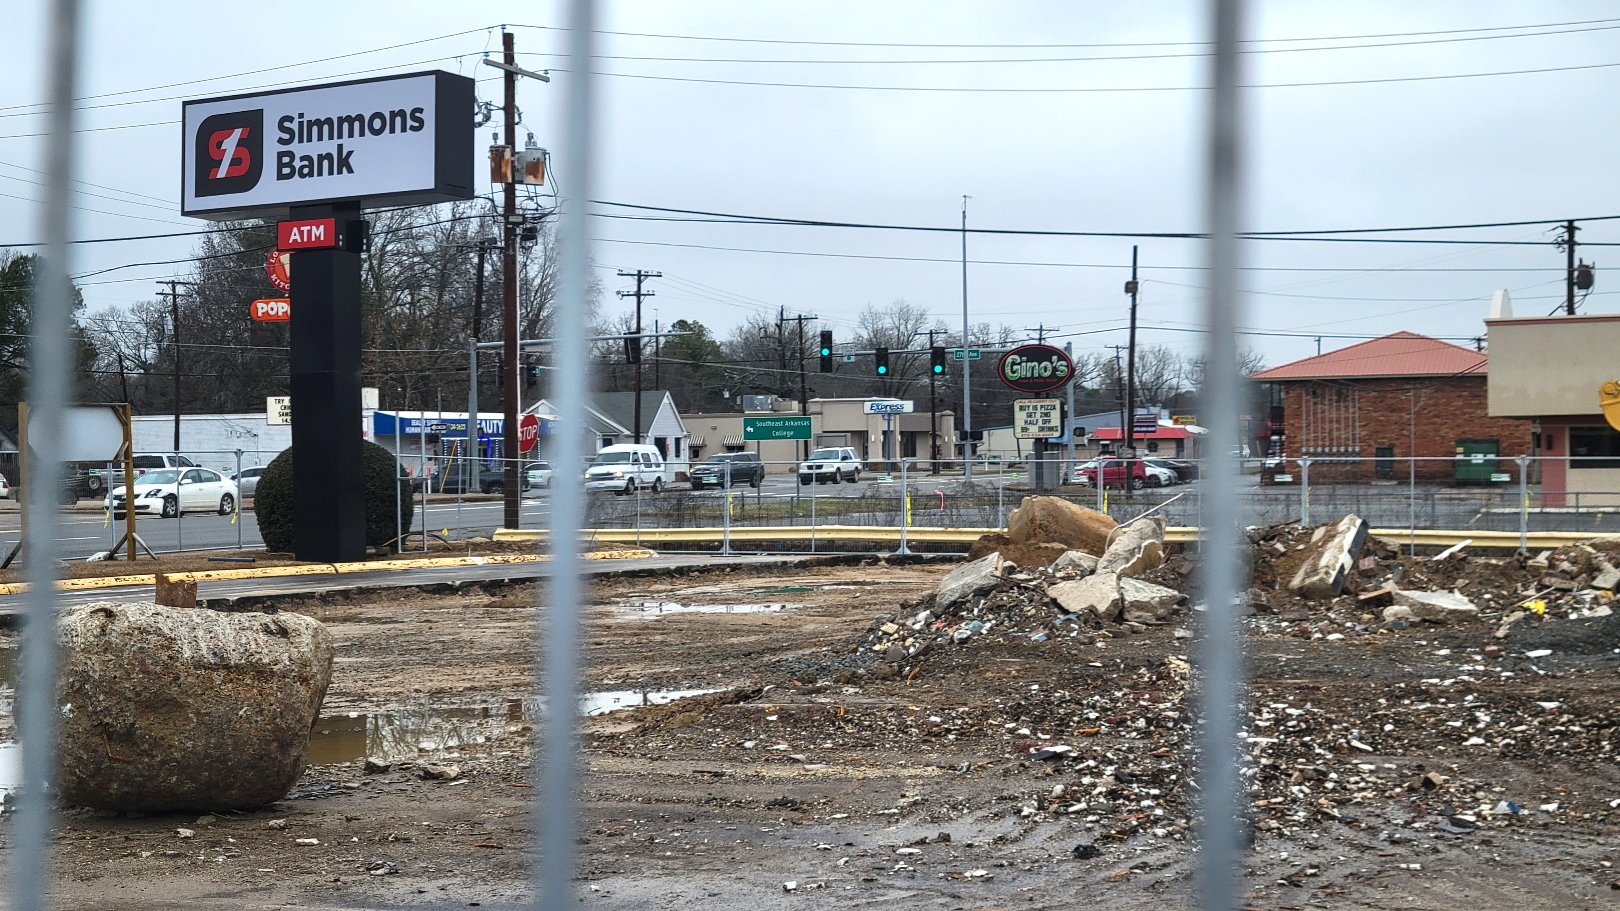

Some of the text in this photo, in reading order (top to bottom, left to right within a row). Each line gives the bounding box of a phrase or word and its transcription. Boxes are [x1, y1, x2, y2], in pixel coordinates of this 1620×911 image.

[276, 107, 425, 146] Simmons
[276, 143, 355, 181] Bank
[288, 224, 325, 244] ATM
[270, 273, 290, 290] KITC
[256, 301, 290, 318] POP
[1005, 354, 1068, 380] Gino's
[477, 419, 504, 434] EAUTY
[519, 424, 537, 441] STOP
[771, 430, 794, 438] College
